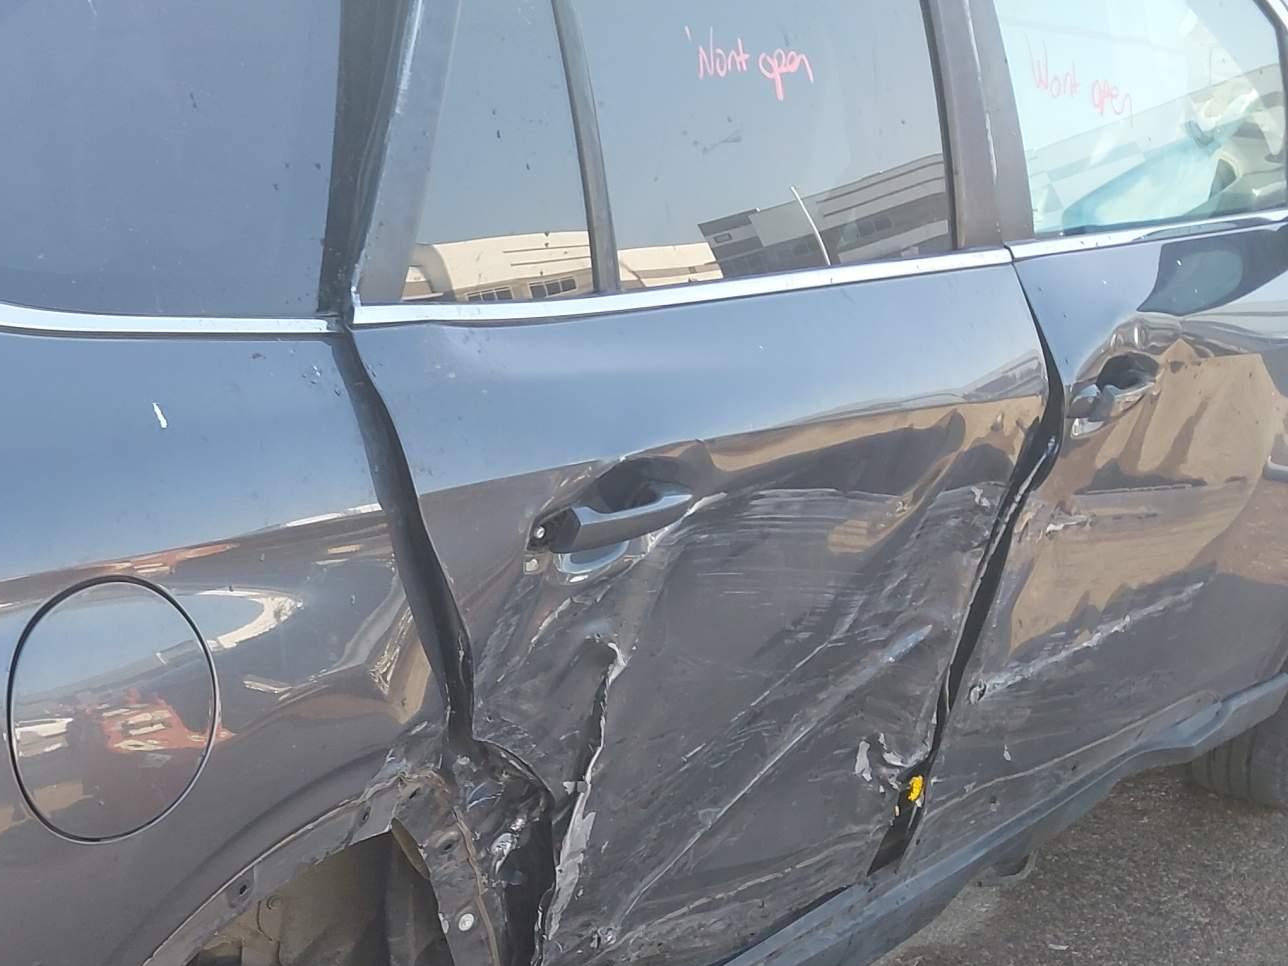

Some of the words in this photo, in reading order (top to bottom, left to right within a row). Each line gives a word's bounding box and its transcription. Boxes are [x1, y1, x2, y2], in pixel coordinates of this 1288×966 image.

[758, 48, 814, 101] open
[1024, 32, 1081, 98] Wont
[1091, 79, 1134, 128] open
